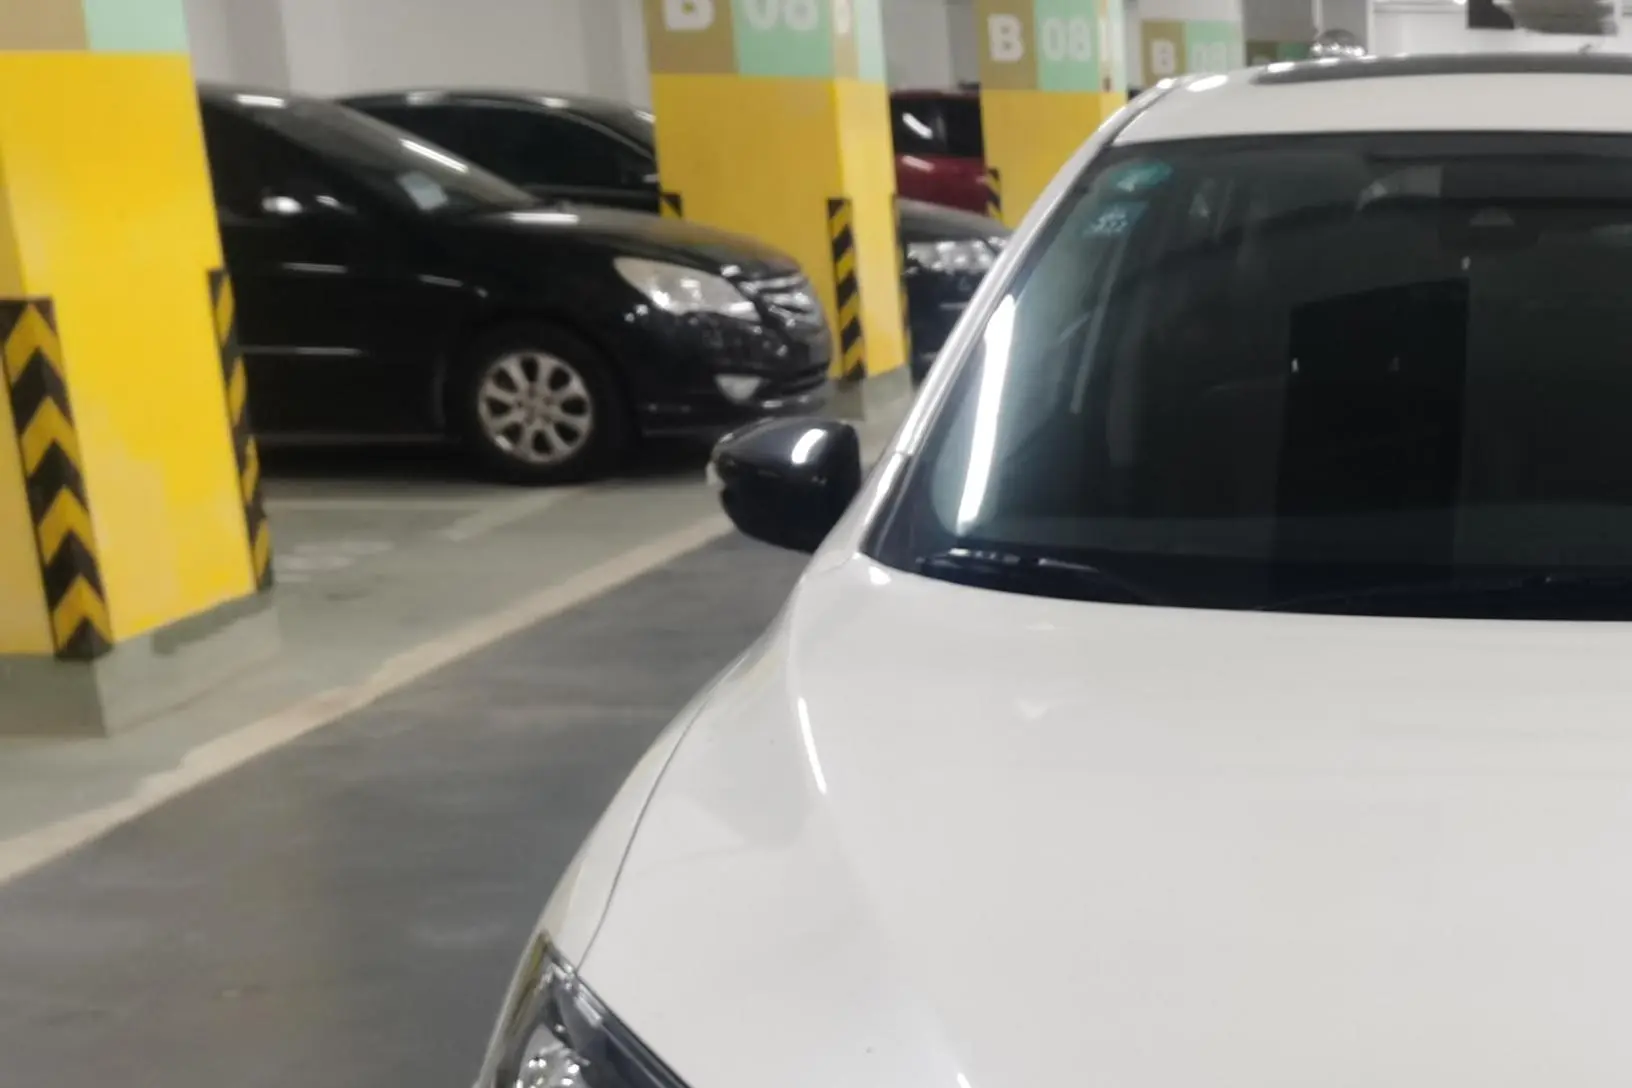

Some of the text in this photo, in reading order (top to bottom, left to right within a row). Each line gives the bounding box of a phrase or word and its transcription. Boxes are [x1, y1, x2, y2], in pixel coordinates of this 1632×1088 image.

[987, 14, 1024, 62] B
[1043, 17, 1092, 61] 08
[1151, 39, 1177, 75] B
